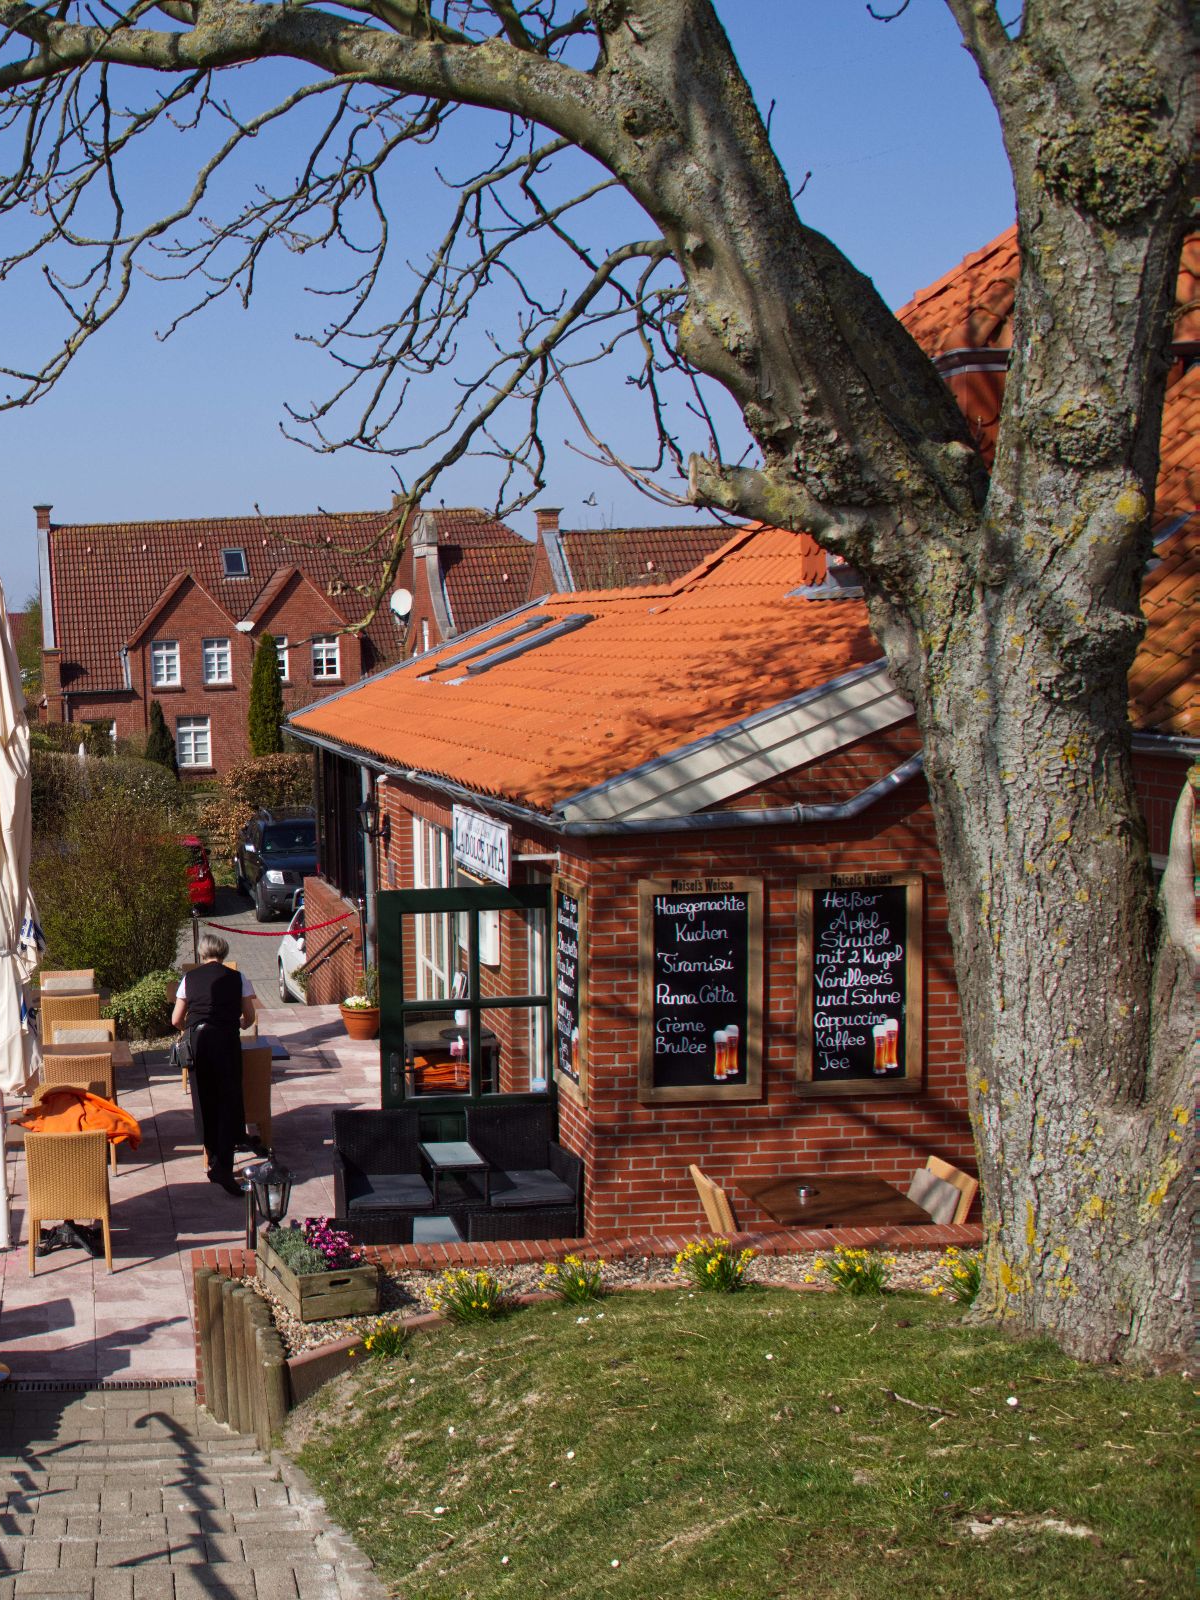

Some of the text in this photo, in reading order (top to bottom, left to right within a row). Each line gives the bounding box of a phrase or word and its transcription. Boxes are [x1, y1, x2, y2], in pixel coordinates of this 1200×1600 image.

[455, 817, 465, 854] LA
[465, 833, 486, 864] DOLCE
[486, 837, 506, 875] VITA
[704, 878, 734, 892] Weisse
[655, 895, 746, 921] Hausgemachte
[822, 891, 883, 911] Heißer
[675, 920, 728, 942] Kuchen
[820, 927, 891, 947] Strudel
[816, 944, 903, 970] mit 2 Kugel
[814, 965, 893, 988] Vanilleeis
[656, 983, 737, 1005] Panna Cotta
[816, 988, 901, 1006] und Sahne
[656, 1017, 706, 1033] Crème
[656, 1036, 707, 1054] Brulée
[815, 1030, 867, 1052] Kaffee
[819, 1050, 851, 1071] Tee
